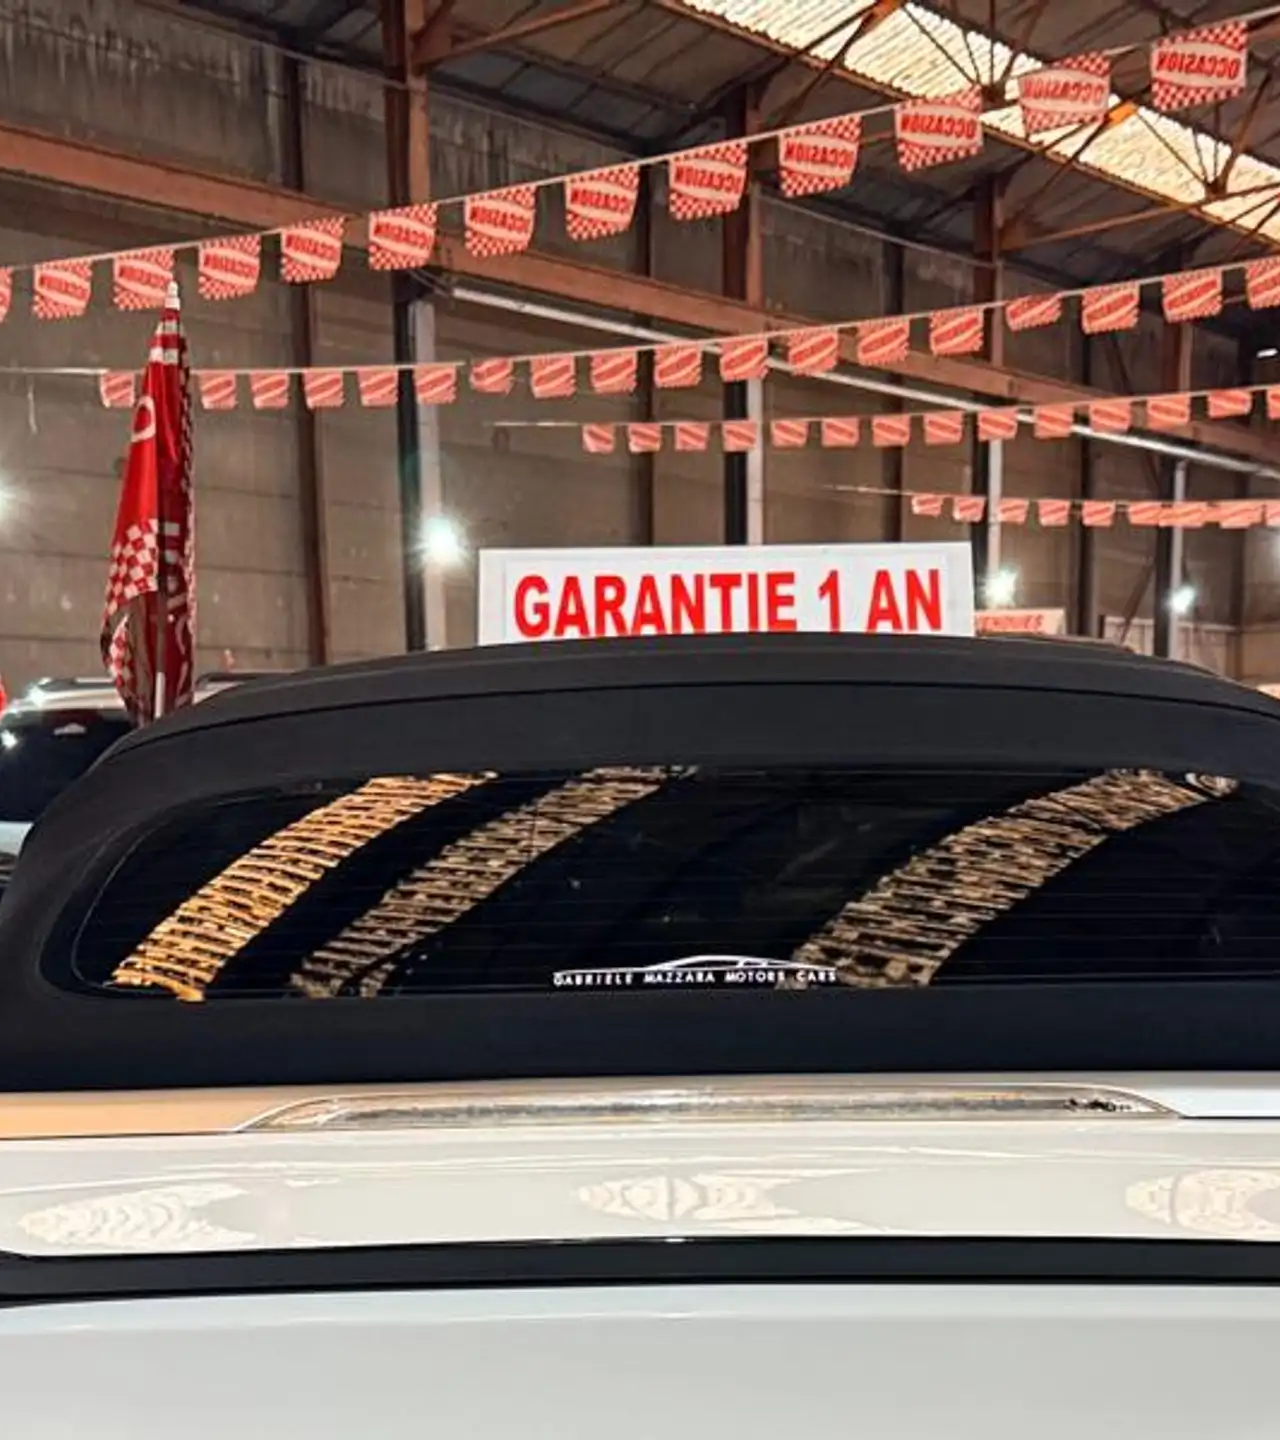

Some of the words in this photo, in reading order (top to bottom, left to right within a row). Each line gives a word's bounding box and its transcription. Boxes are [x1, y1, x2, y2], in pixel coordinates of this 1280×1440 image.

[514, 571, 796, 637] GARANTIE
[819, 570, 840, 633] 1
[867, 568, 941, 632] AN
[553, 972, 634, 987] GABRIELE
[643, 972, 715, 984] MAZZARA
[725, 971, 785, 984] MOTORS
[796, 971, 836, 983] CARS
